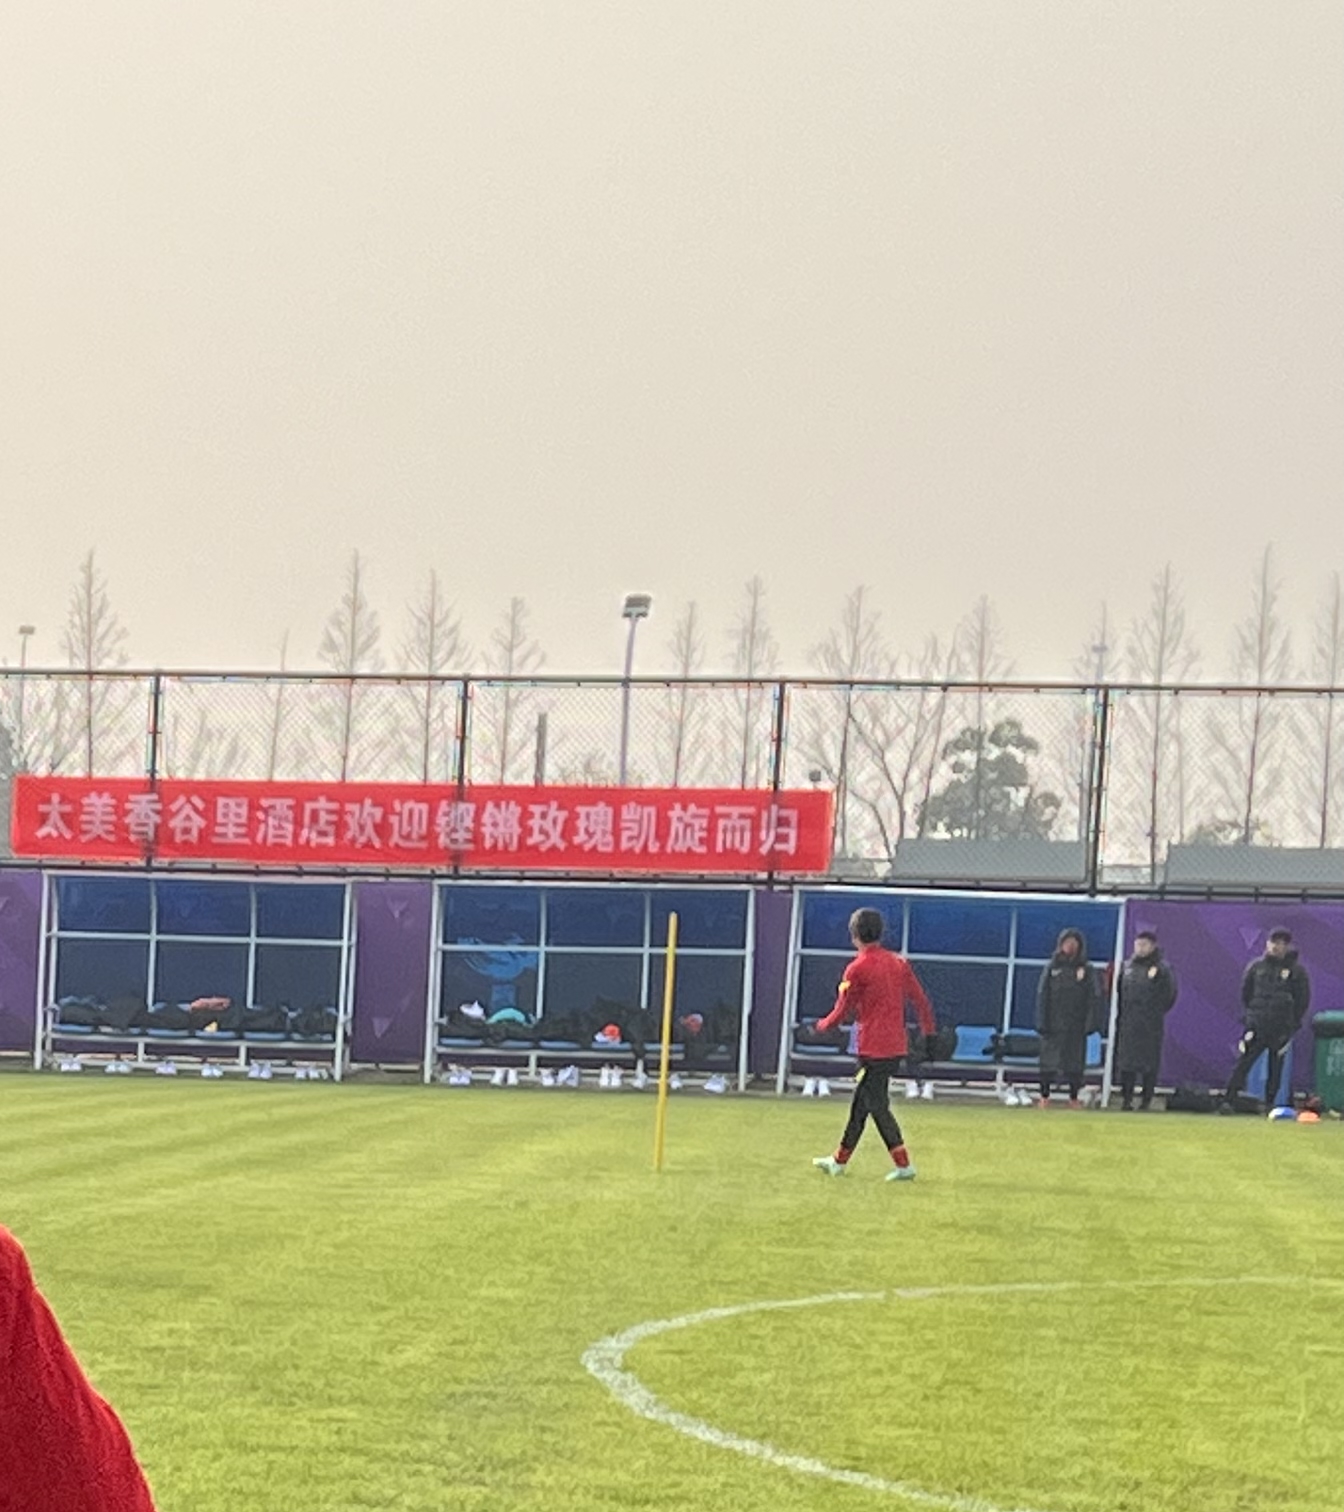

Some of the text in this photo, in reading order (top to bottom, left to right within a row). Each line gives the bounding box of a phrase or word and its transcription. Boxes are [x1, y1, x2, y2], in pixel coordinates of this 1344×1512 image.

[34, 791, 799, 856] 太美香谷里酒店欢迎铿锵玫瑰凯旋而归
